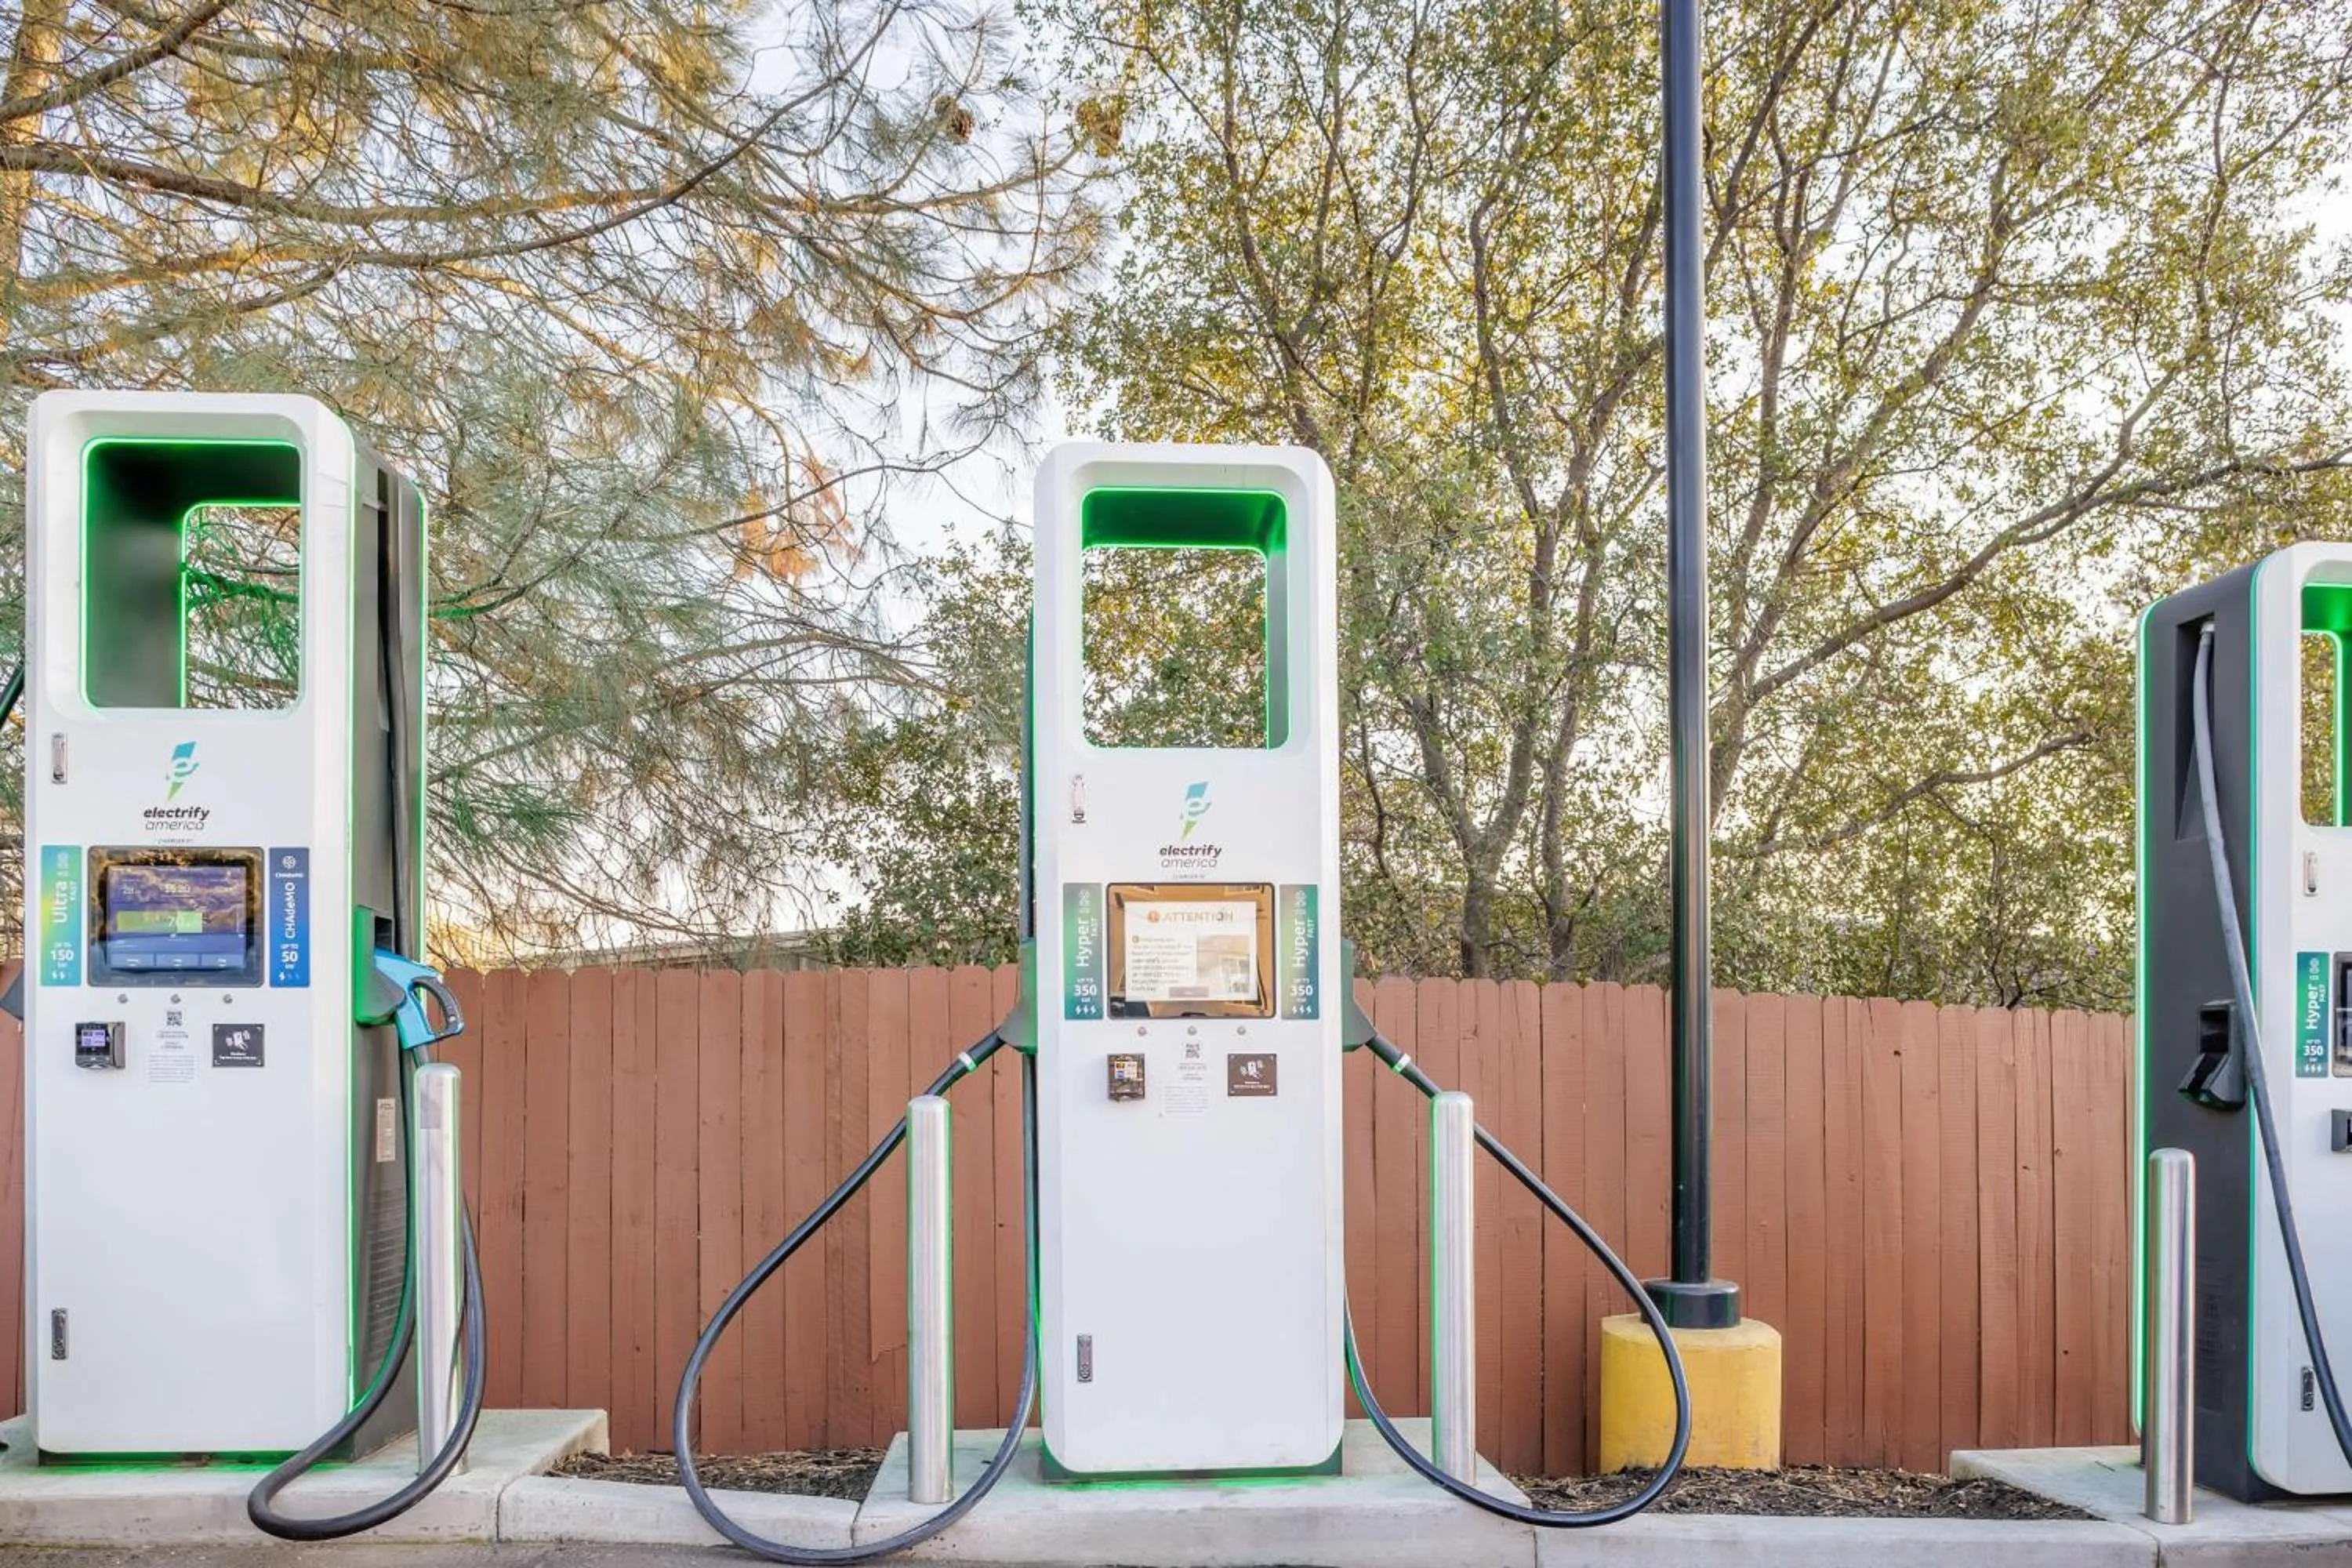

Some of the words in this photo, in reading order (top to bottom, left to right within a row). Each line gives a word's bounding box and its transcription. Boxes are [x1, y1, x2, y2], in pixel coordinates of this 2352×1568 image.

[143, 806, 210, 821] electrify
[145, 820, 205, 830] america
[1160, 844, 1222, 858] electrify
[1161, 858, 1218, 868] america
[51, 880, 68, 924] Ultra
[285, 882, 296, 938] CHAdeMO
[1163, 911, 1234, 922] ATTENTION
[1076, 917, 1092, 967] Hyper
[1292, 919, 1308, 967] Hyper
[50, 949, 74, 961] 150
[281, 951, 298, 963] 50
[1073, 985, 1098, 996] 350
[1290, 985, 1313, 996] 350
[2306, 984, 2321, 1030] Hyper
[2303, 1045, 2324, 1057] 350
